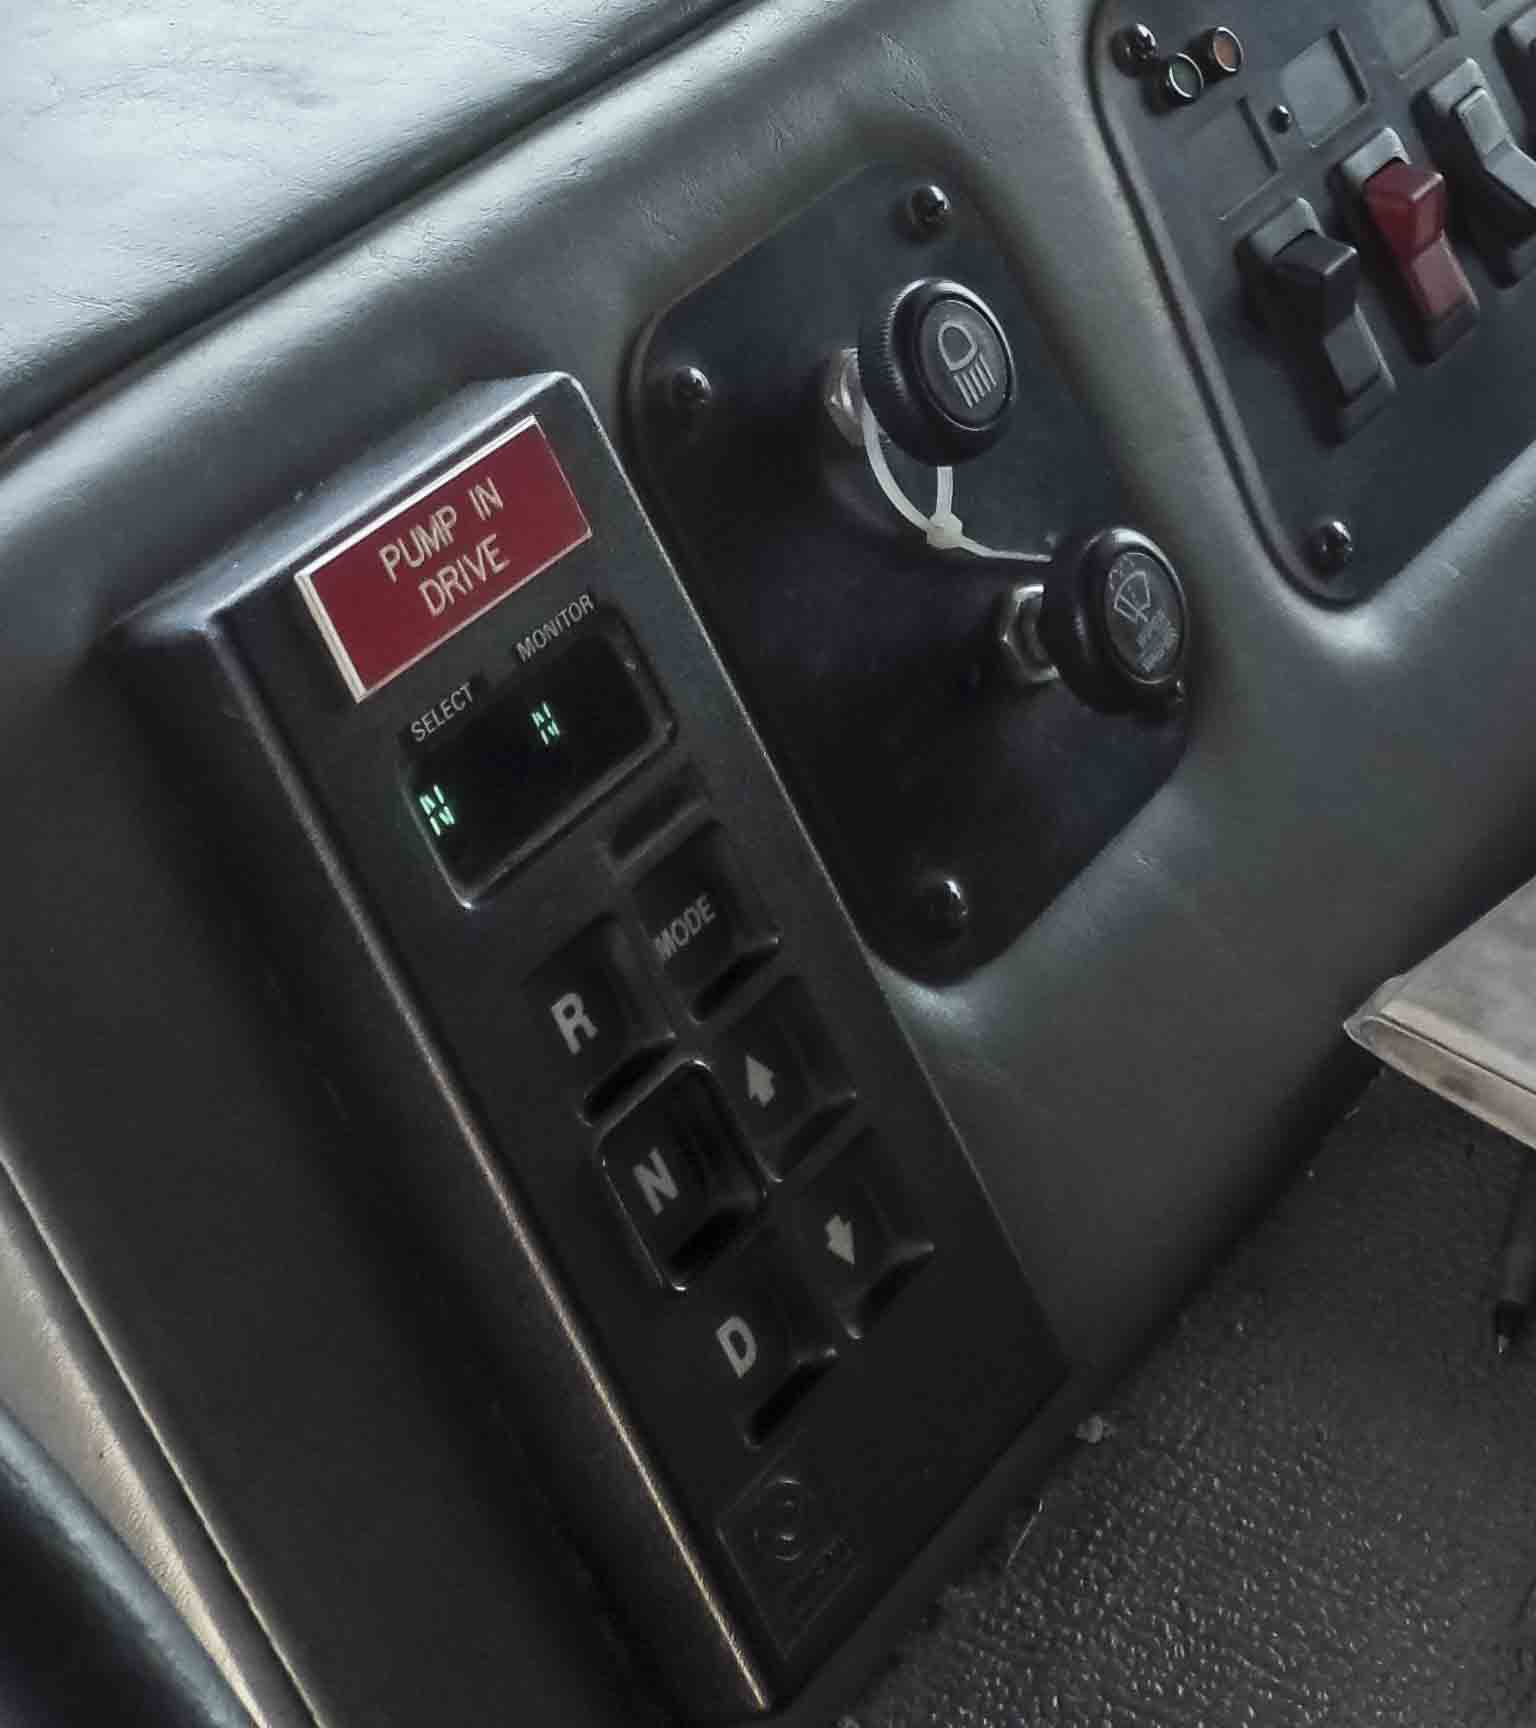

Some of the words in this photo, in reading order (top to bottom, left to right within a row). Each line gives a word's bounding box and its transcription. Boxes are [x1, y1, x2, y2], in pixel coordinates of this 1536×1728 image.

[377, 503, 458, 583] PUMP
[467, 477, 505, 521] IN
[418, 533, 511, 617] DRIVE
[515, 592, 595, 664] MONITOR
[409, 681, 474, 743] SELECT
[655, 894, 717, 960] MODE
[550, 991, 598, 1055] R
[632, 1146, 680, 1216] N
[715, 1314, 759, 1379] D
